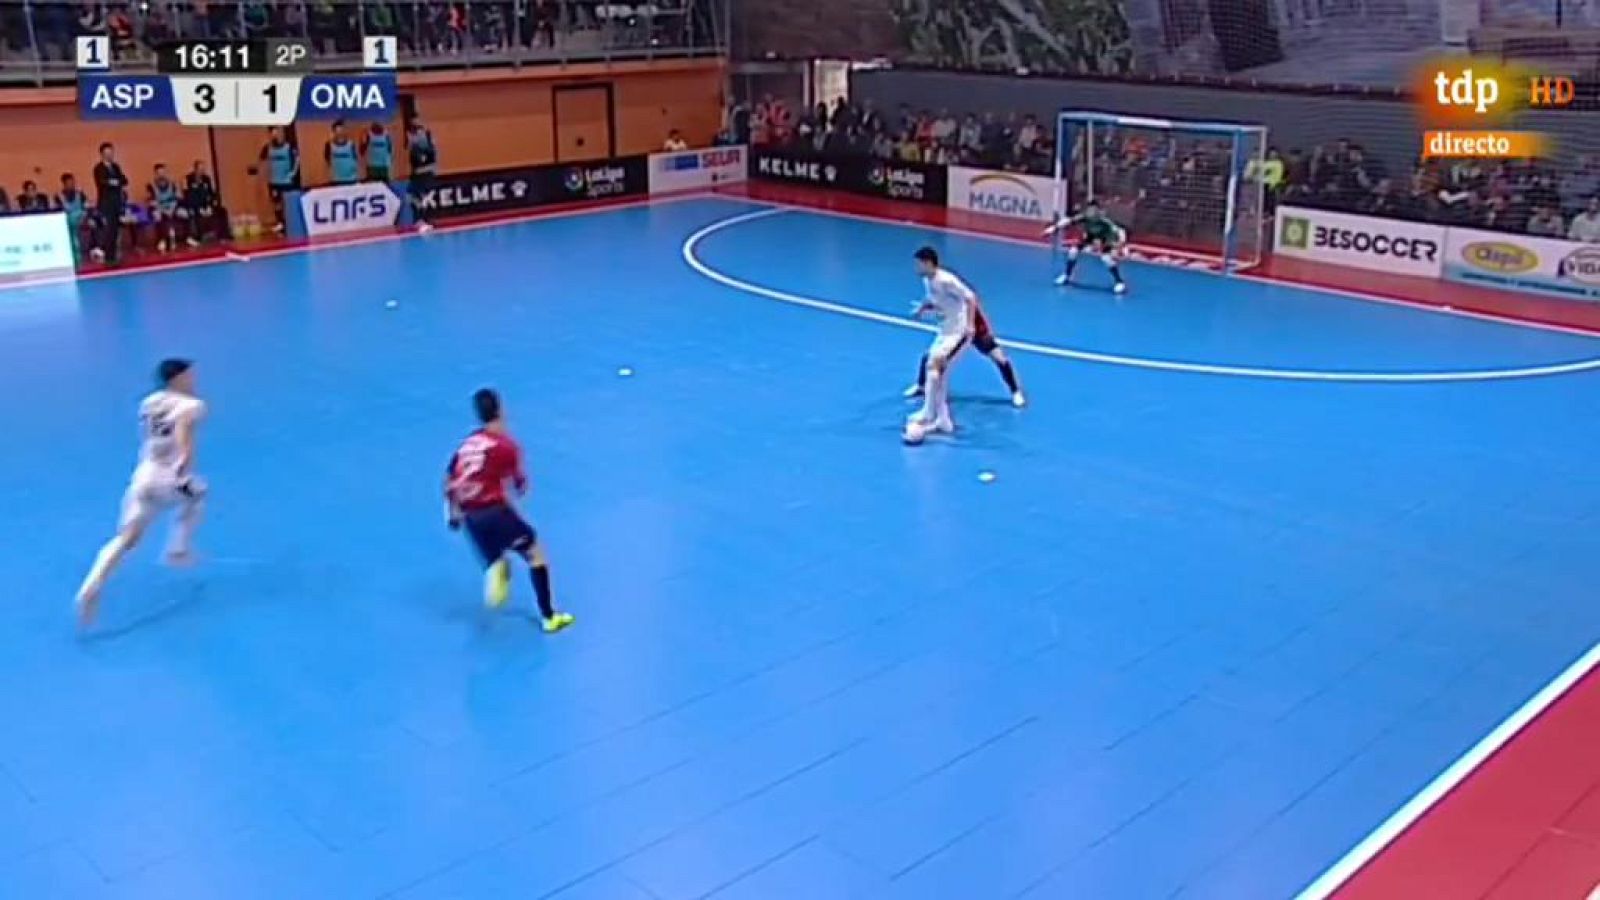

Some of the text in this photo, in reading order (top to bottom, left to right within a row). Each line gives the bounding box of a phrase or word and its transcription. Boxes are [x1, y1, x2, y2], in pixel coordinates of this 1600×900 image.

[759, 157, 821, 181] KELME
[420, 182, 506, 209] KELME
[969, 191, 1042, 216] MAGNA
[1313, 226, 1438, 263] BESOCCER
